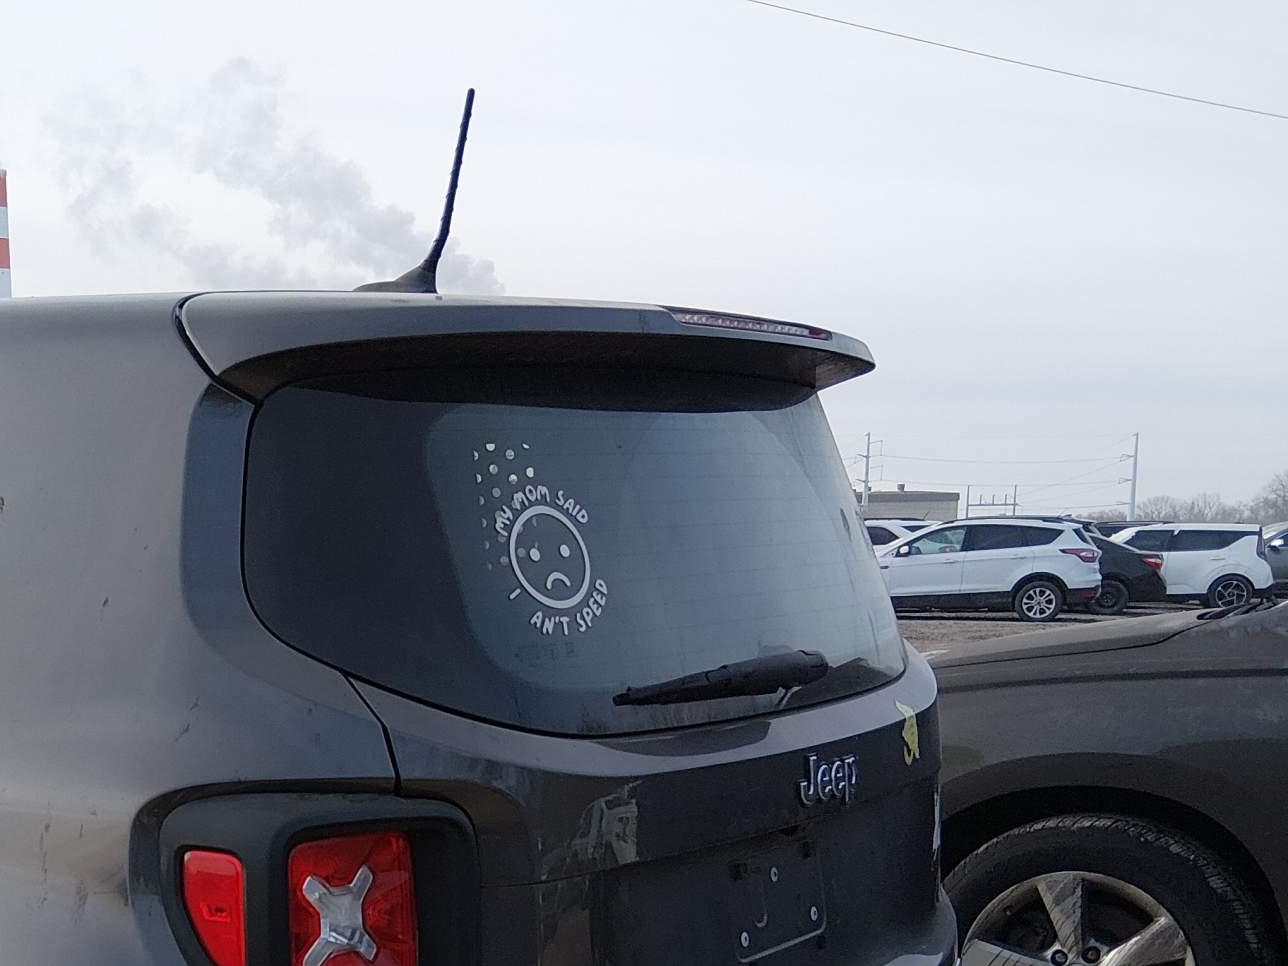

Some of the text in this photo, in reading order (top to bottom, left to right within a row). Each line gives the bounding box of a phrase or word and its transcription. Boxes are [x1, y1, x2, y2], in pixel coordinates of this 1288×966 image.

[495, 485, 588, 537] MY MOM SAID
[576, 579, 608, 632] SPEED
[800, 753, 856, 803] Jeep
